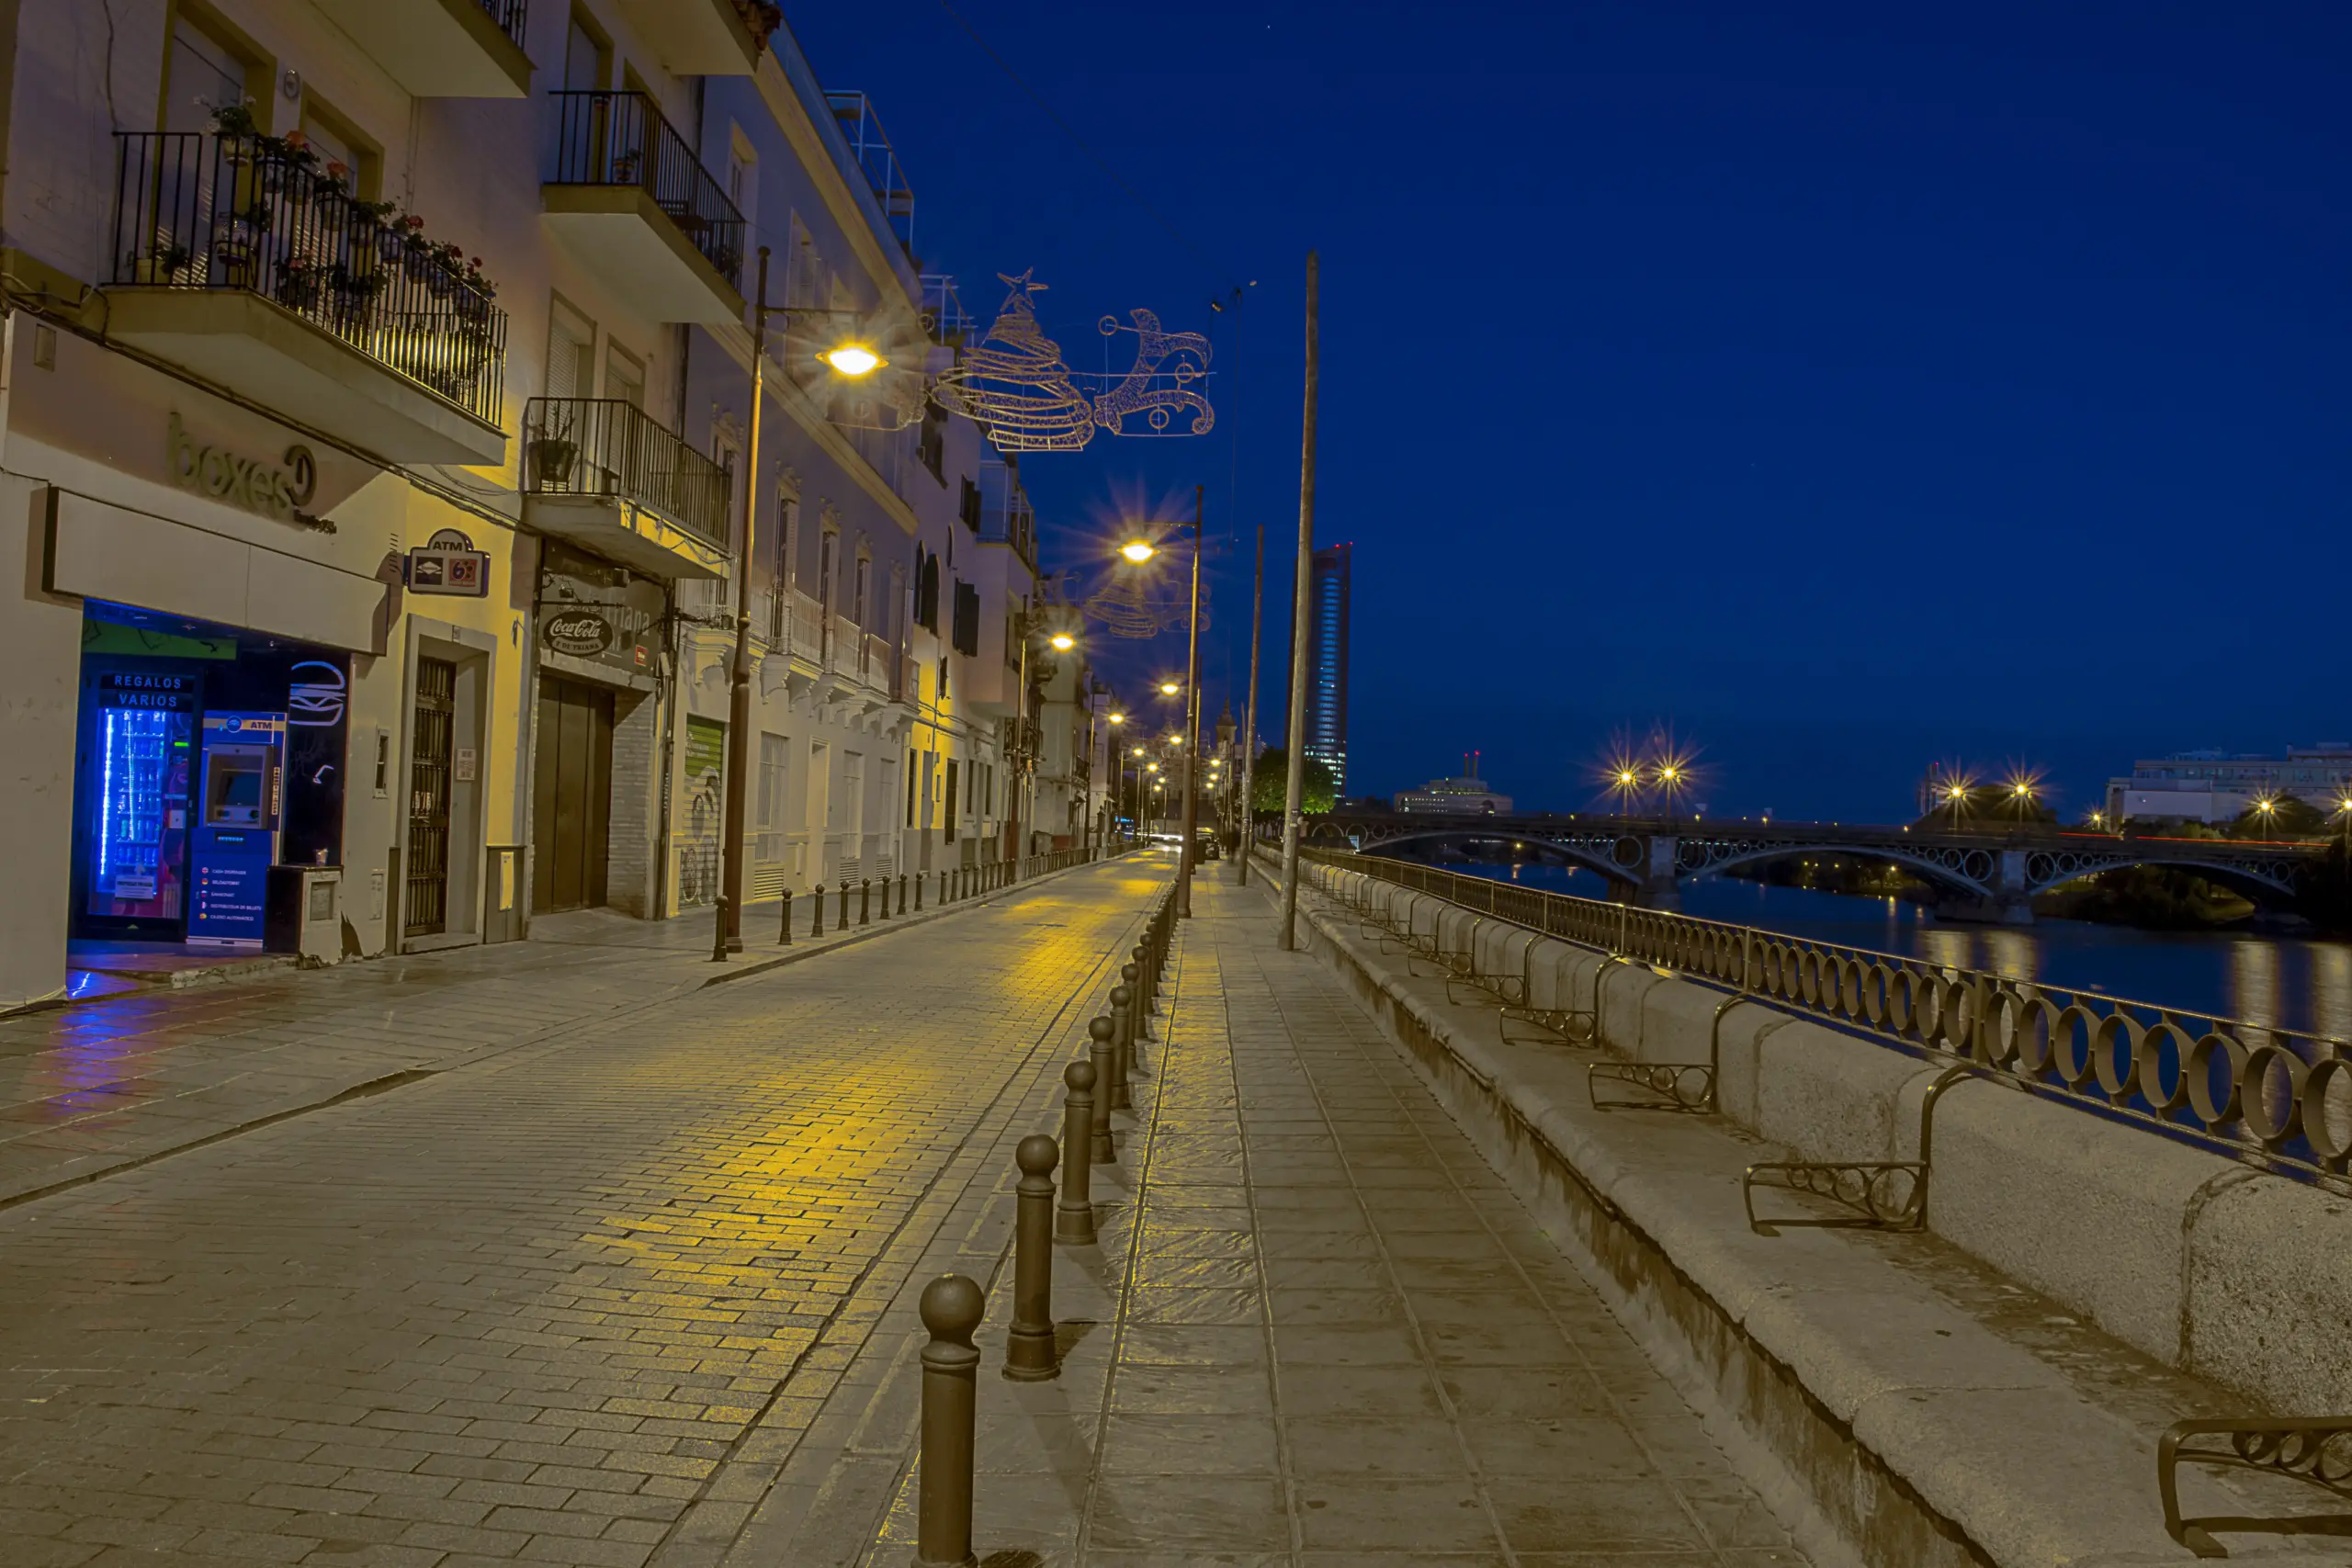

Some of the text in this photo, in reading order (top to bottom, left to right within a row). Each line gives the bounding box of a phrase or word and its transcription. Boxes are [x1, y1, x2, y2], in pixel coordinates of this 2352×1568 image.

[170, 412, 291, 522] boxes
[433, 541, 462, 551] ATM
[572, 642, 600, 651] TRIANA
[114, 674, 181, 689] REGALOS
[119, 694, 177, 707] VARIOS
[250, 721, 273, 729] ATM
